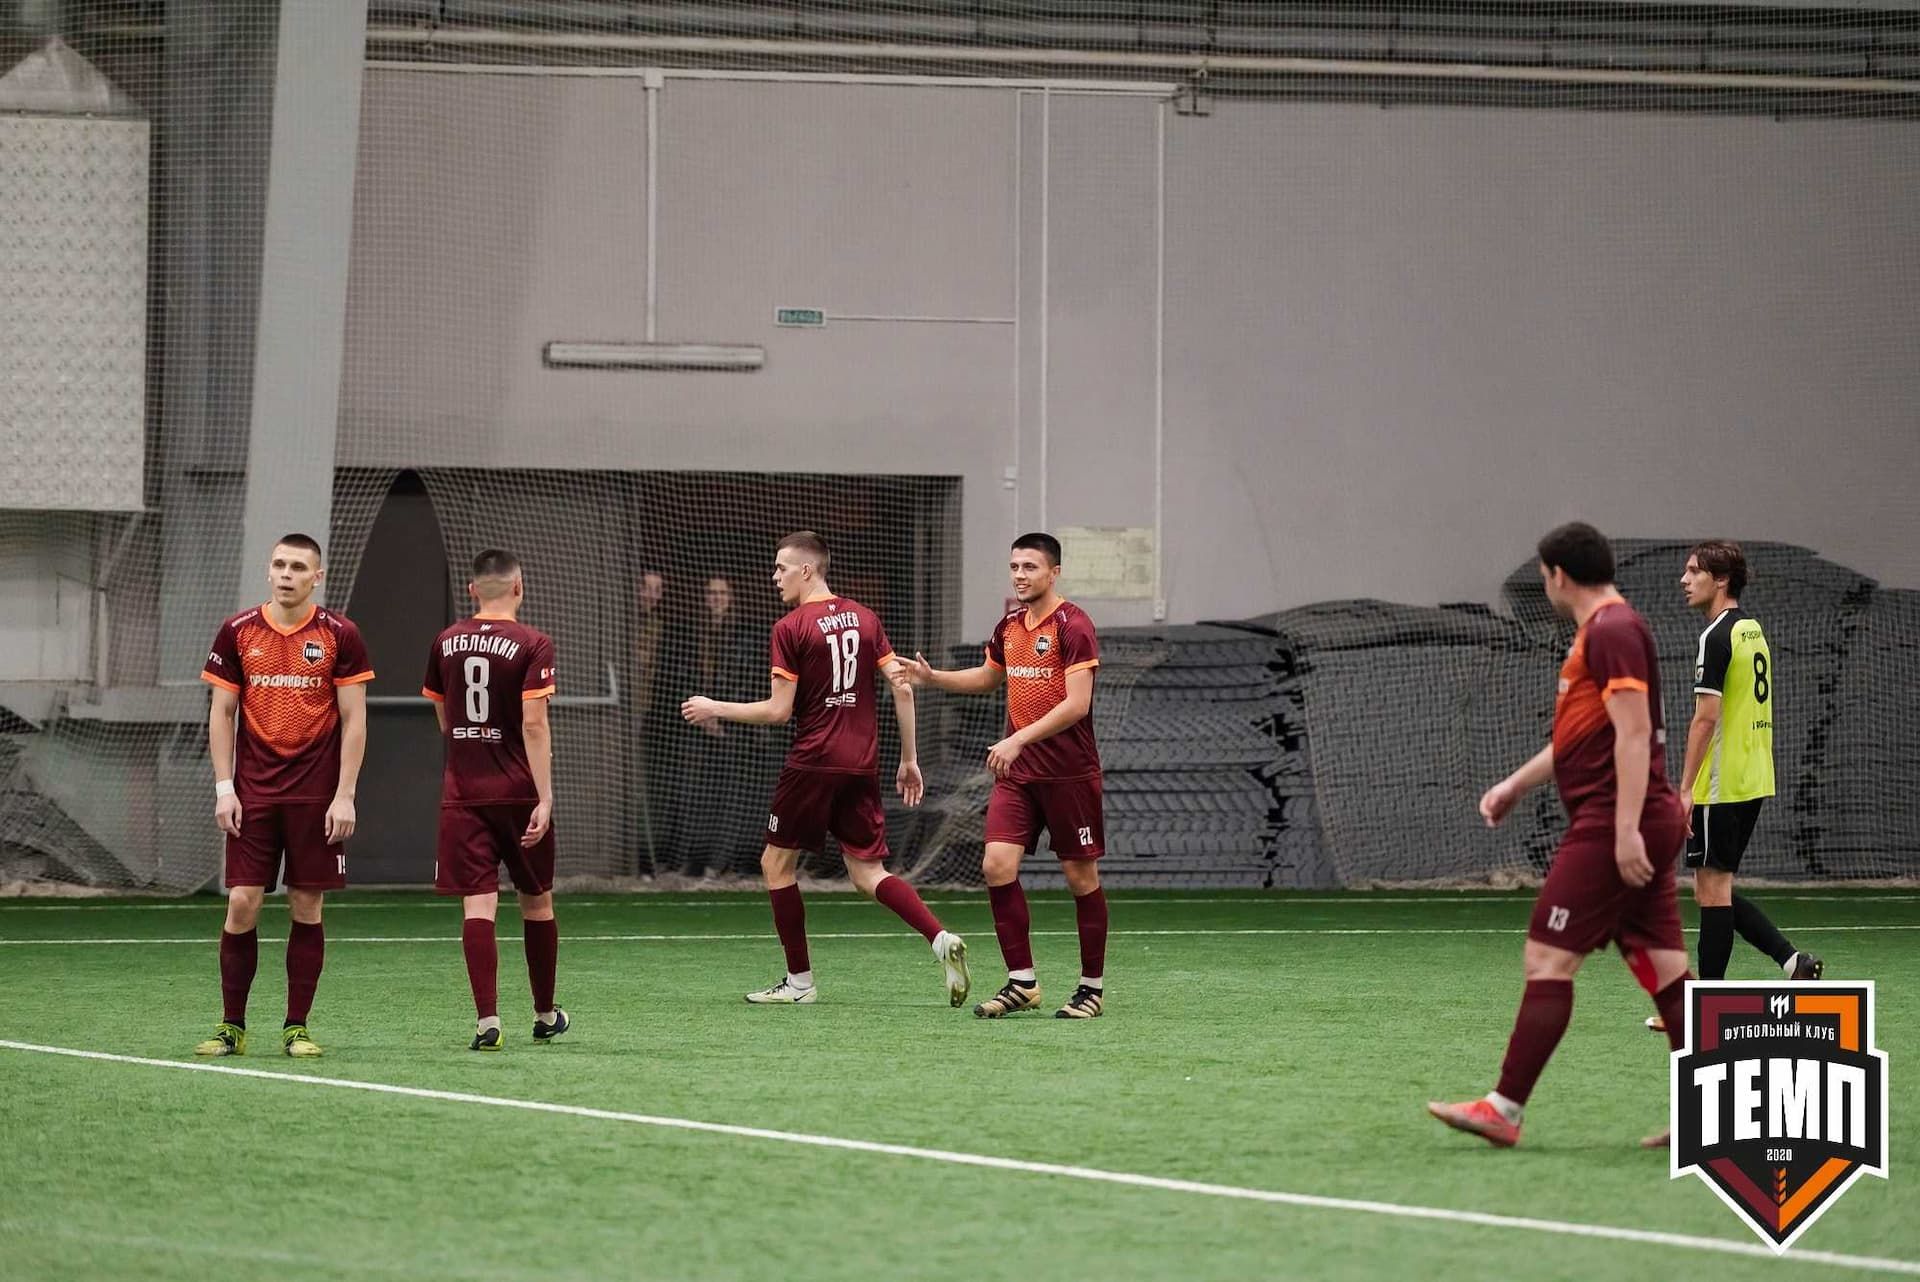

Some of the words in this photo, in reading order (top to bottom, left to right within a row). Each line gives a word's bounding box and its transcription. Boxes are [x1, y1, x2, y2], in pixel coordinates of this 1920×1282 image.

[442, 634, 520, 660] ЩЕБЛЫКИН
[826, 629, 860, 693] 18
[464, 656, 490, 723] 8
[1753, 652, 1769, 704] 8
[453, 727, 502, 739] SEUS
[767, 814, 779, 832] 18
[1547, 906, 1570, 931] 13
